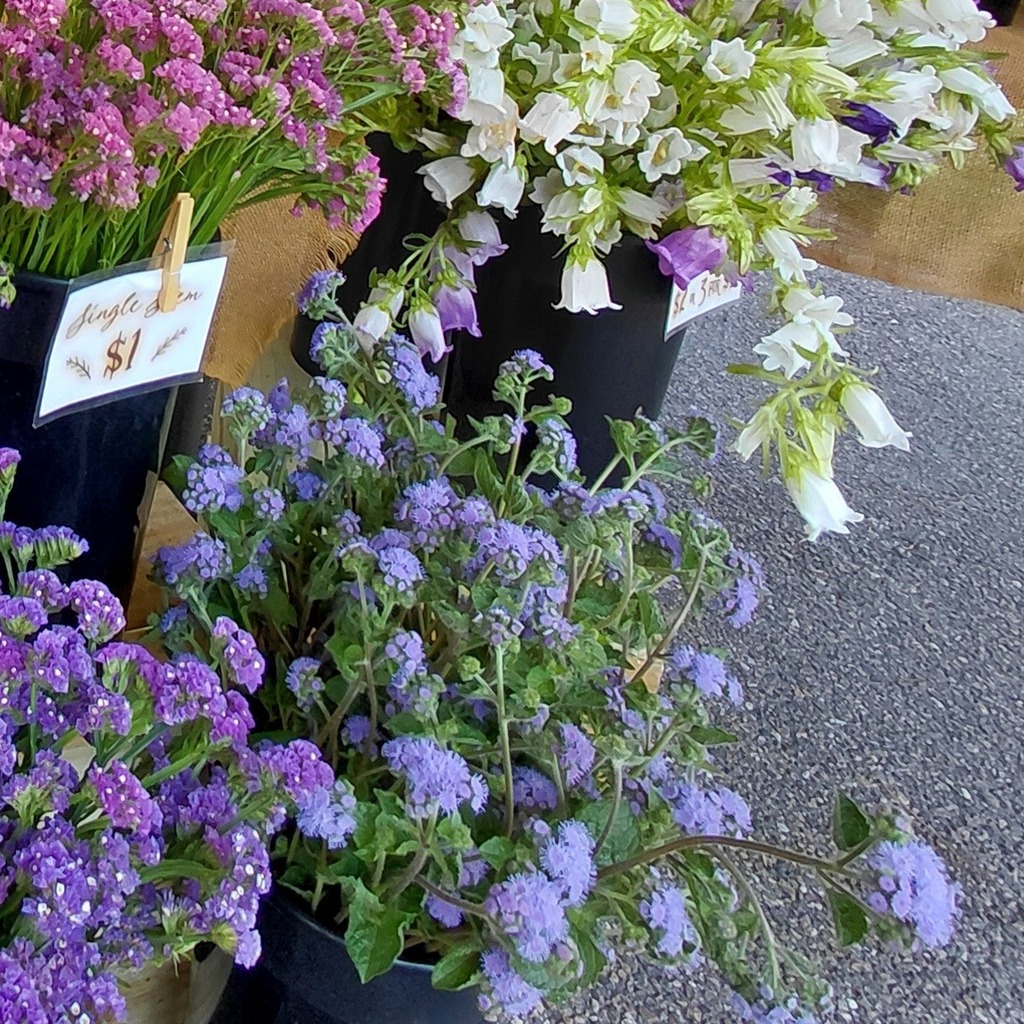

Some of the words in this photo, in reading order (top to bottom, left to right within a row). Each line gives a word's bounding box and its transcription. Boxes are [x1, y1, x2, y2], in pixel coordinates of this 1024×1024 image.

[66, 292, 143, 340] Single
[144, 290, 203, 319] Sem
[698, 277, 708, 308] 3
[103, 327, 142, 380] $1
